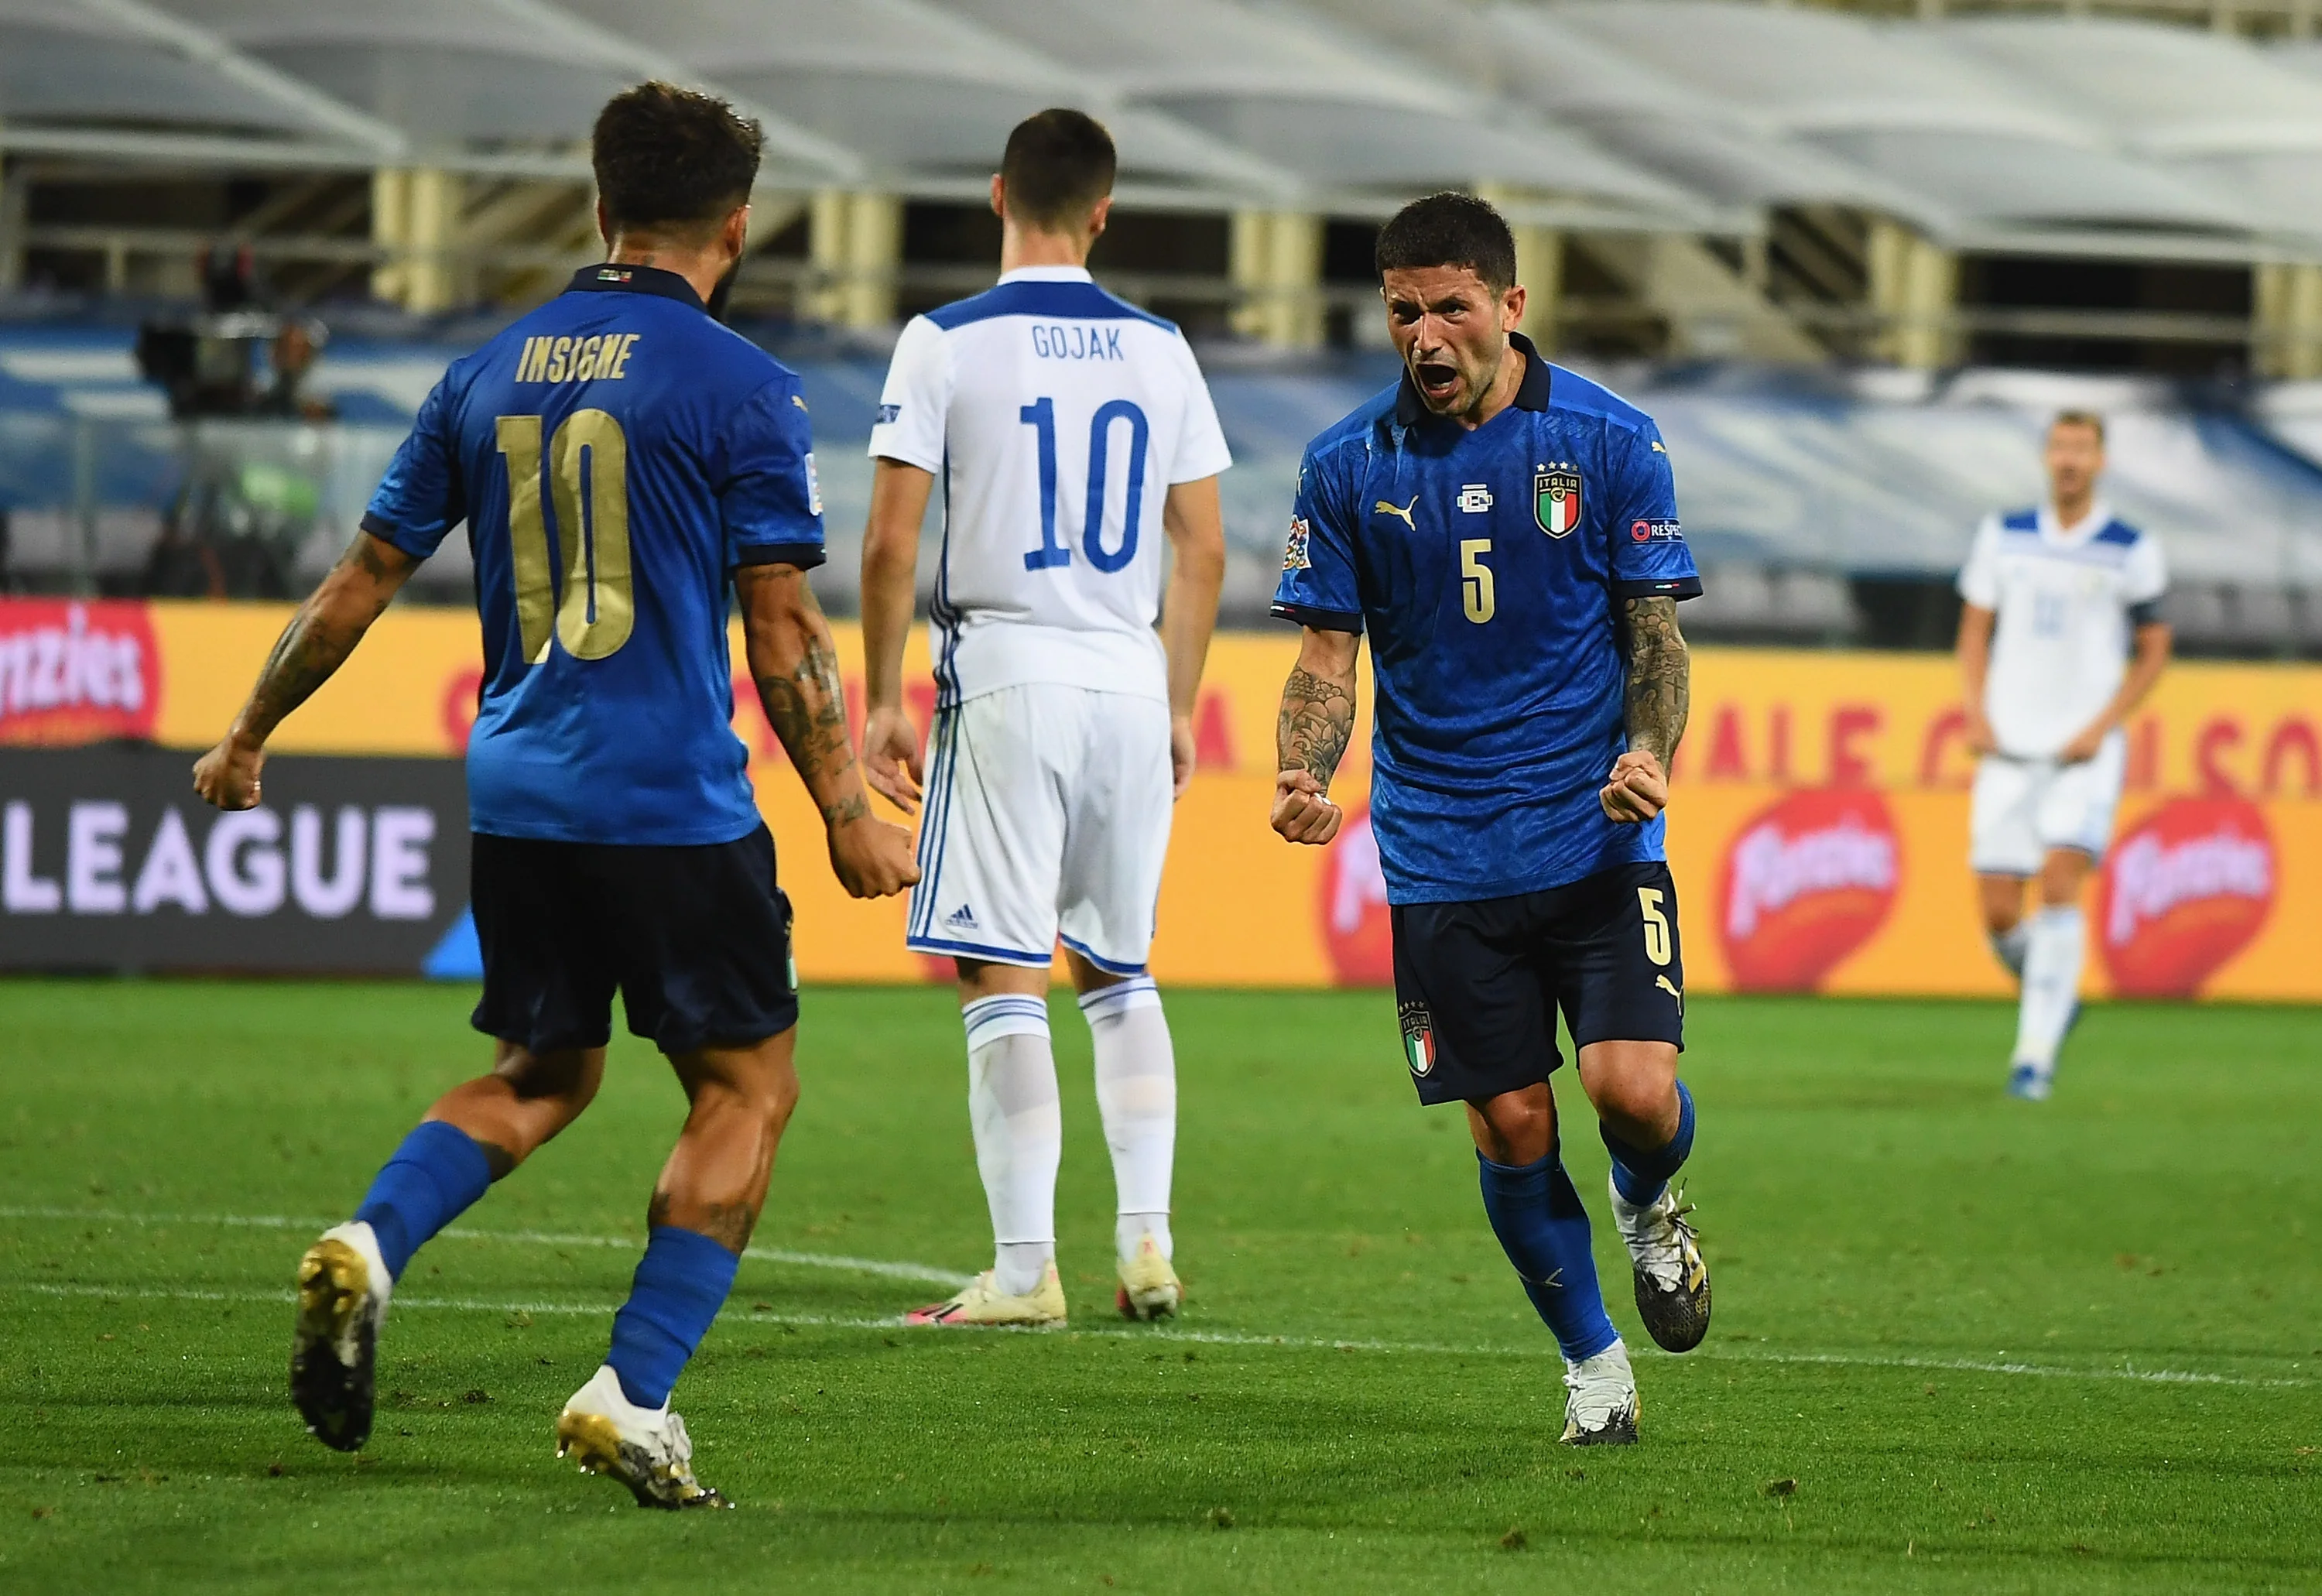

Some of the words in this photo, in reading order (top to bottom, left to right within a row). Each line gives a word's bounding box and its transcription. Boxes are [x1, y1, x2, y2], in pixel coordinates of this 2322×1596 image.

[515, 334, 640, 383] INSIGNE
[1032, 325, 1124, 361] GOJAK
[1020, 397, 1149, 574] 10
[1539, 478, 1577, 488] ITALIA
[496, 408, 634, 664] 10
[1460, 539, 1495, 624] 5
[2, 801, 436, 919] LEAGUE
[1637, 887, 1671, 966] 5
[1402, 1015, 1428, 1029] ITALIA
